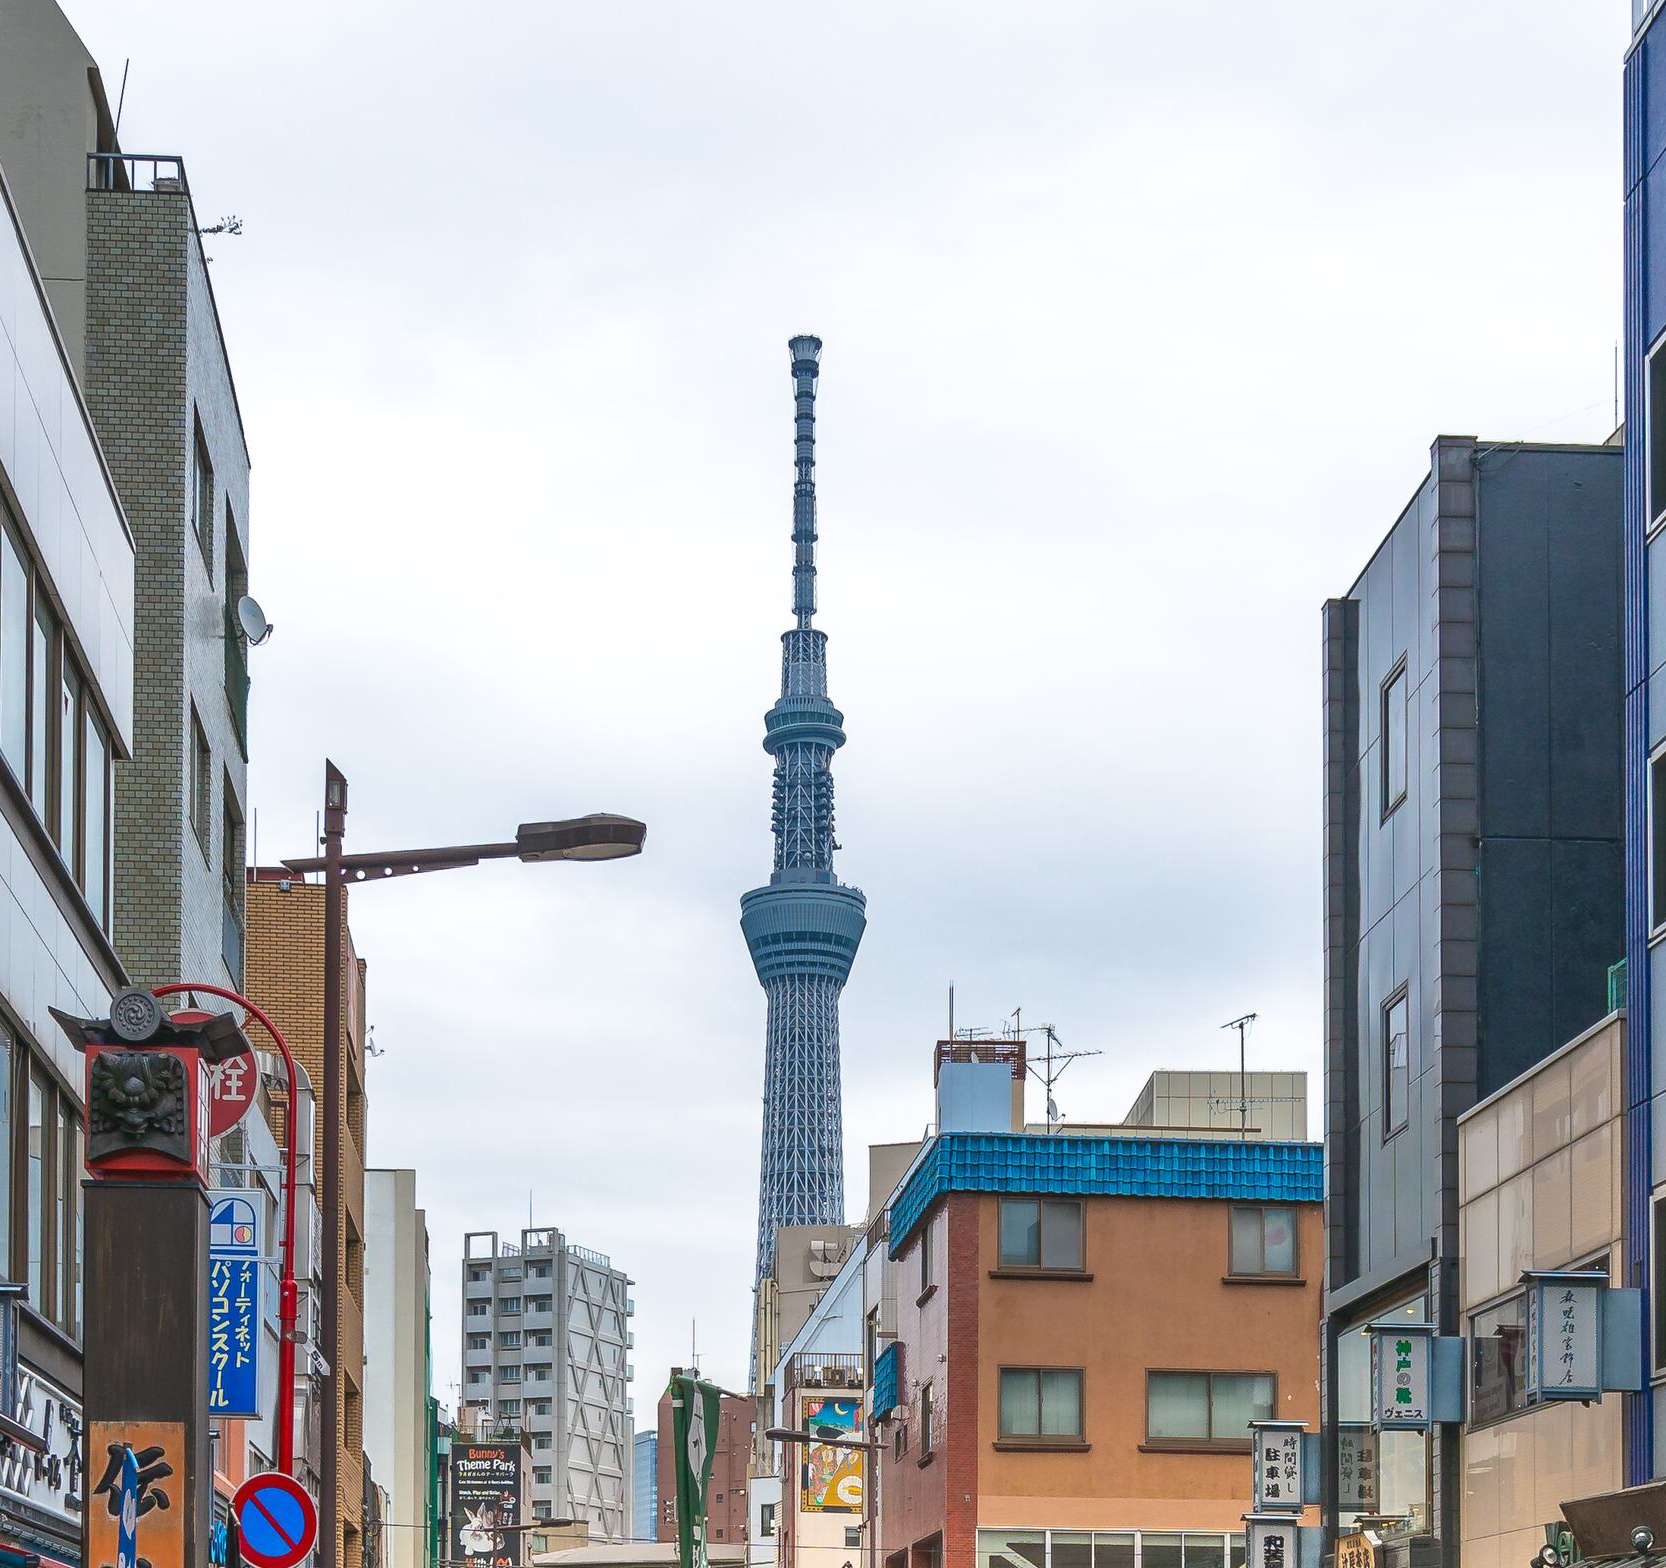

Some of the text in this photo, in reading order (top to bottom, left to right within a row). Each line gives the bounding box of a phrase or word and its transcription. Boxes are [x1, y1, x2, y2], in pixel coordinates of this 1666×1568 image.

[210, 1260, 232, 1408] パソコンスクール
[1384, 1408, 1423, 1419] ヴェニス
[456, 1459, 516, 1472] Theme Park
[468, 1448, 505, 1460] Bunny's
[1283, 1435, 1297, 1494] 時間貸し
[1265, 1448, 1280, 1499] 駐車場
